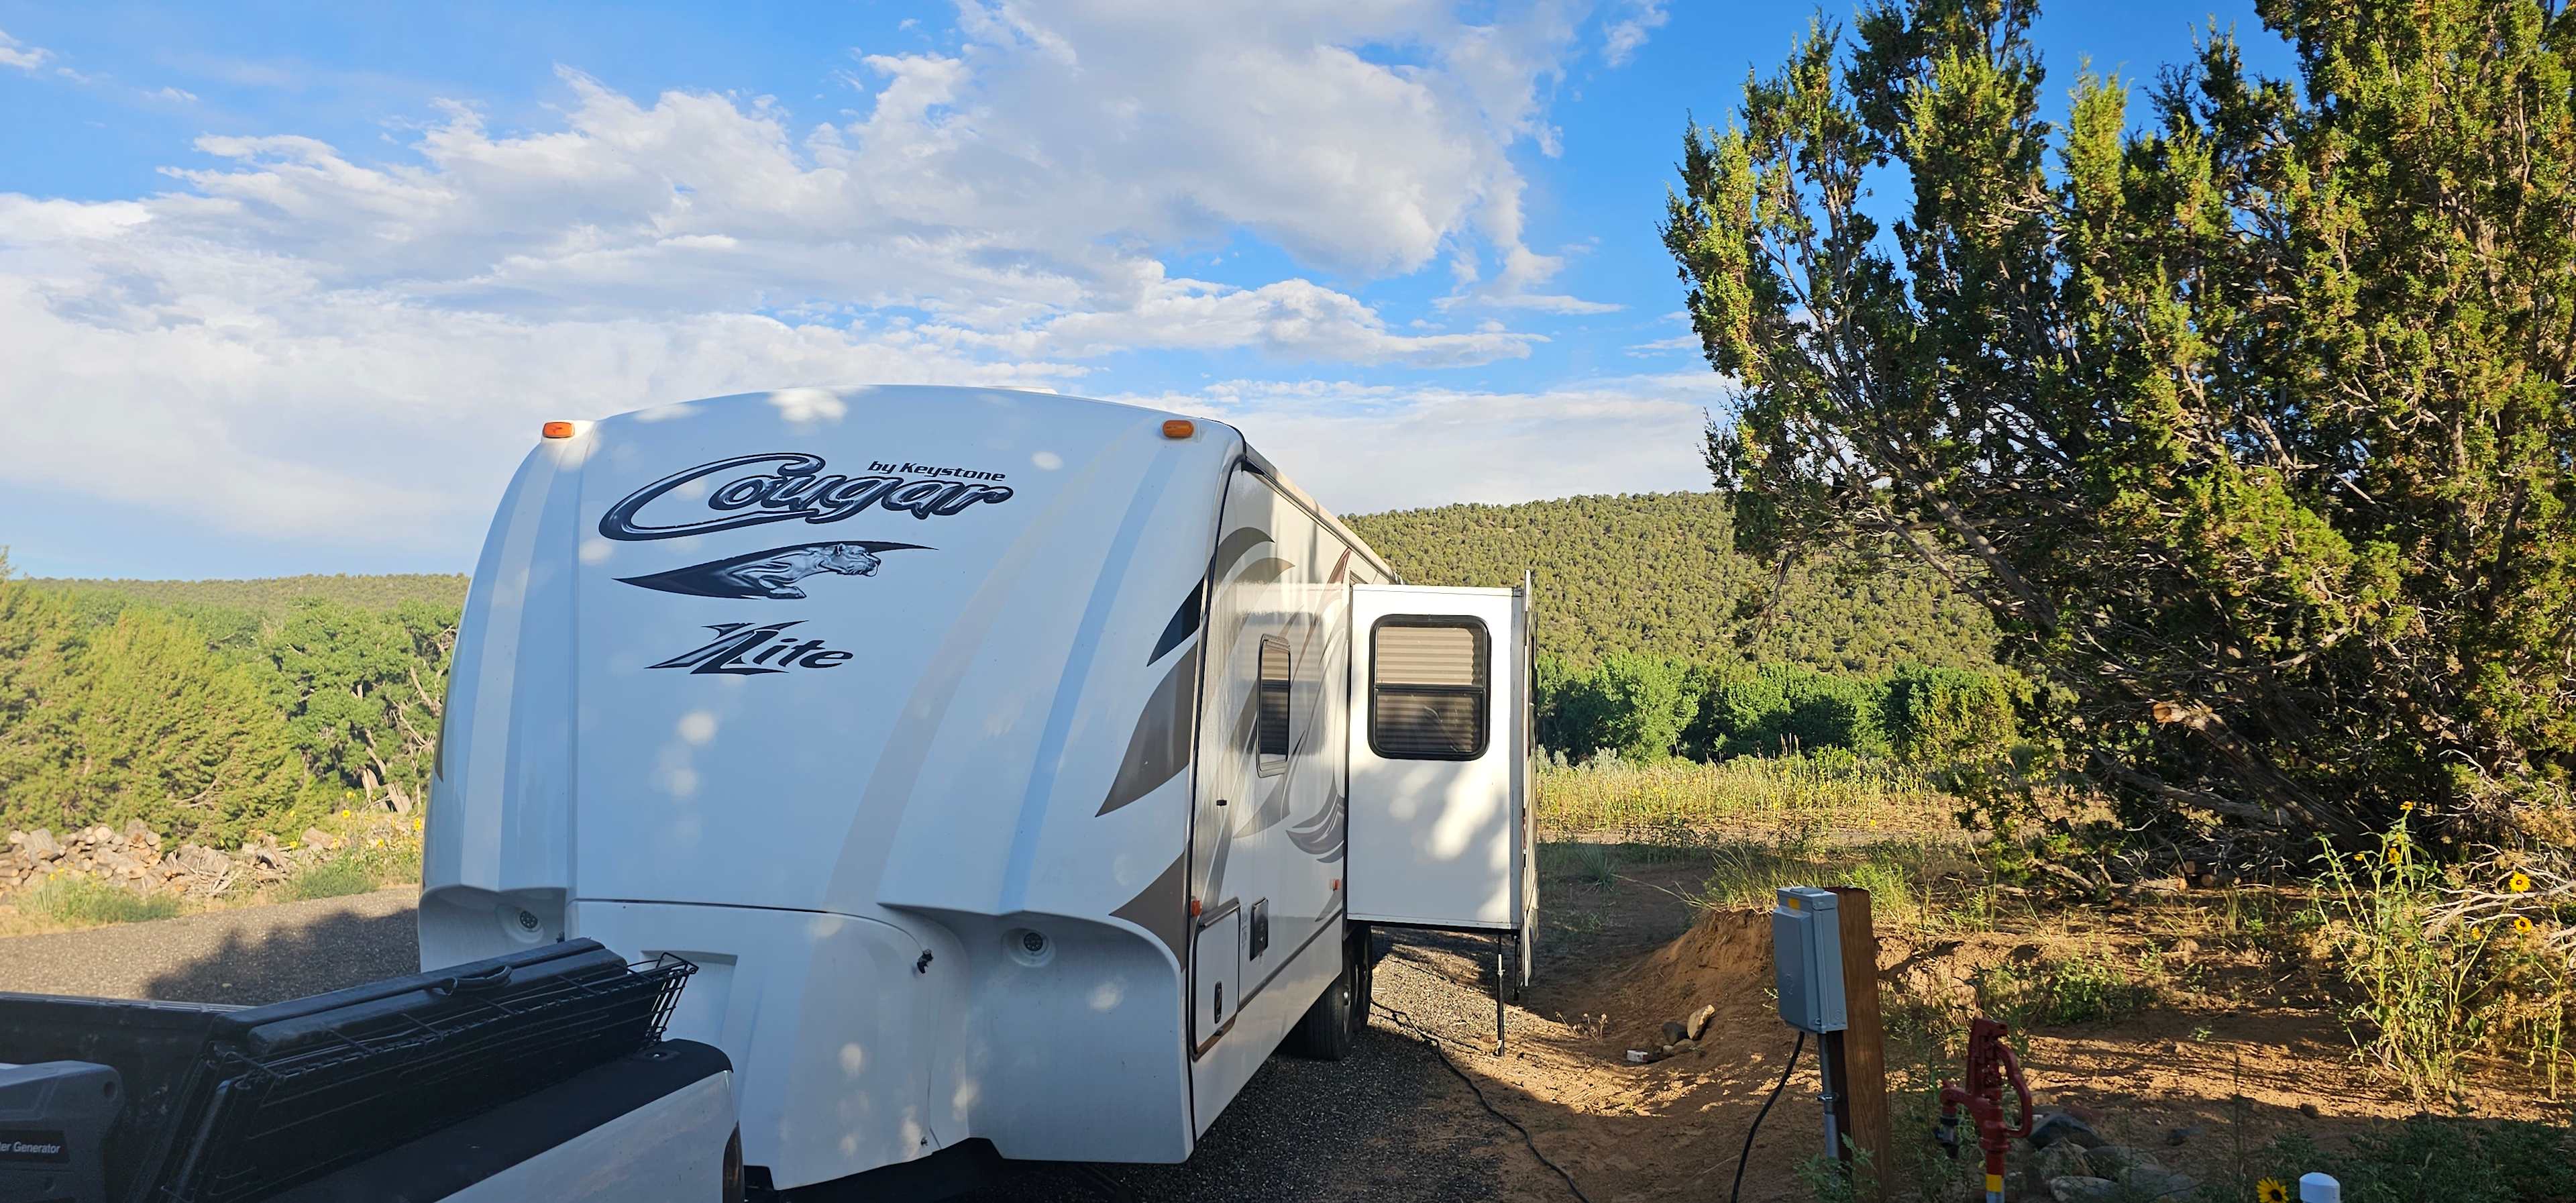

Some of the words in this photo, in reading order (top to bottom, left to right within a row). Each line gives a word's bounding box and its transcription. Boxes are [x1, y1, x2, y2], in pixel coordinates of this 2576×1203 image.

[867, 461, 896, 474] by
[899, 463, 1006, 481] Keystone
[599, 453, 1013, 541] Cougar
[13, 1141, 60, 1153] Generator
